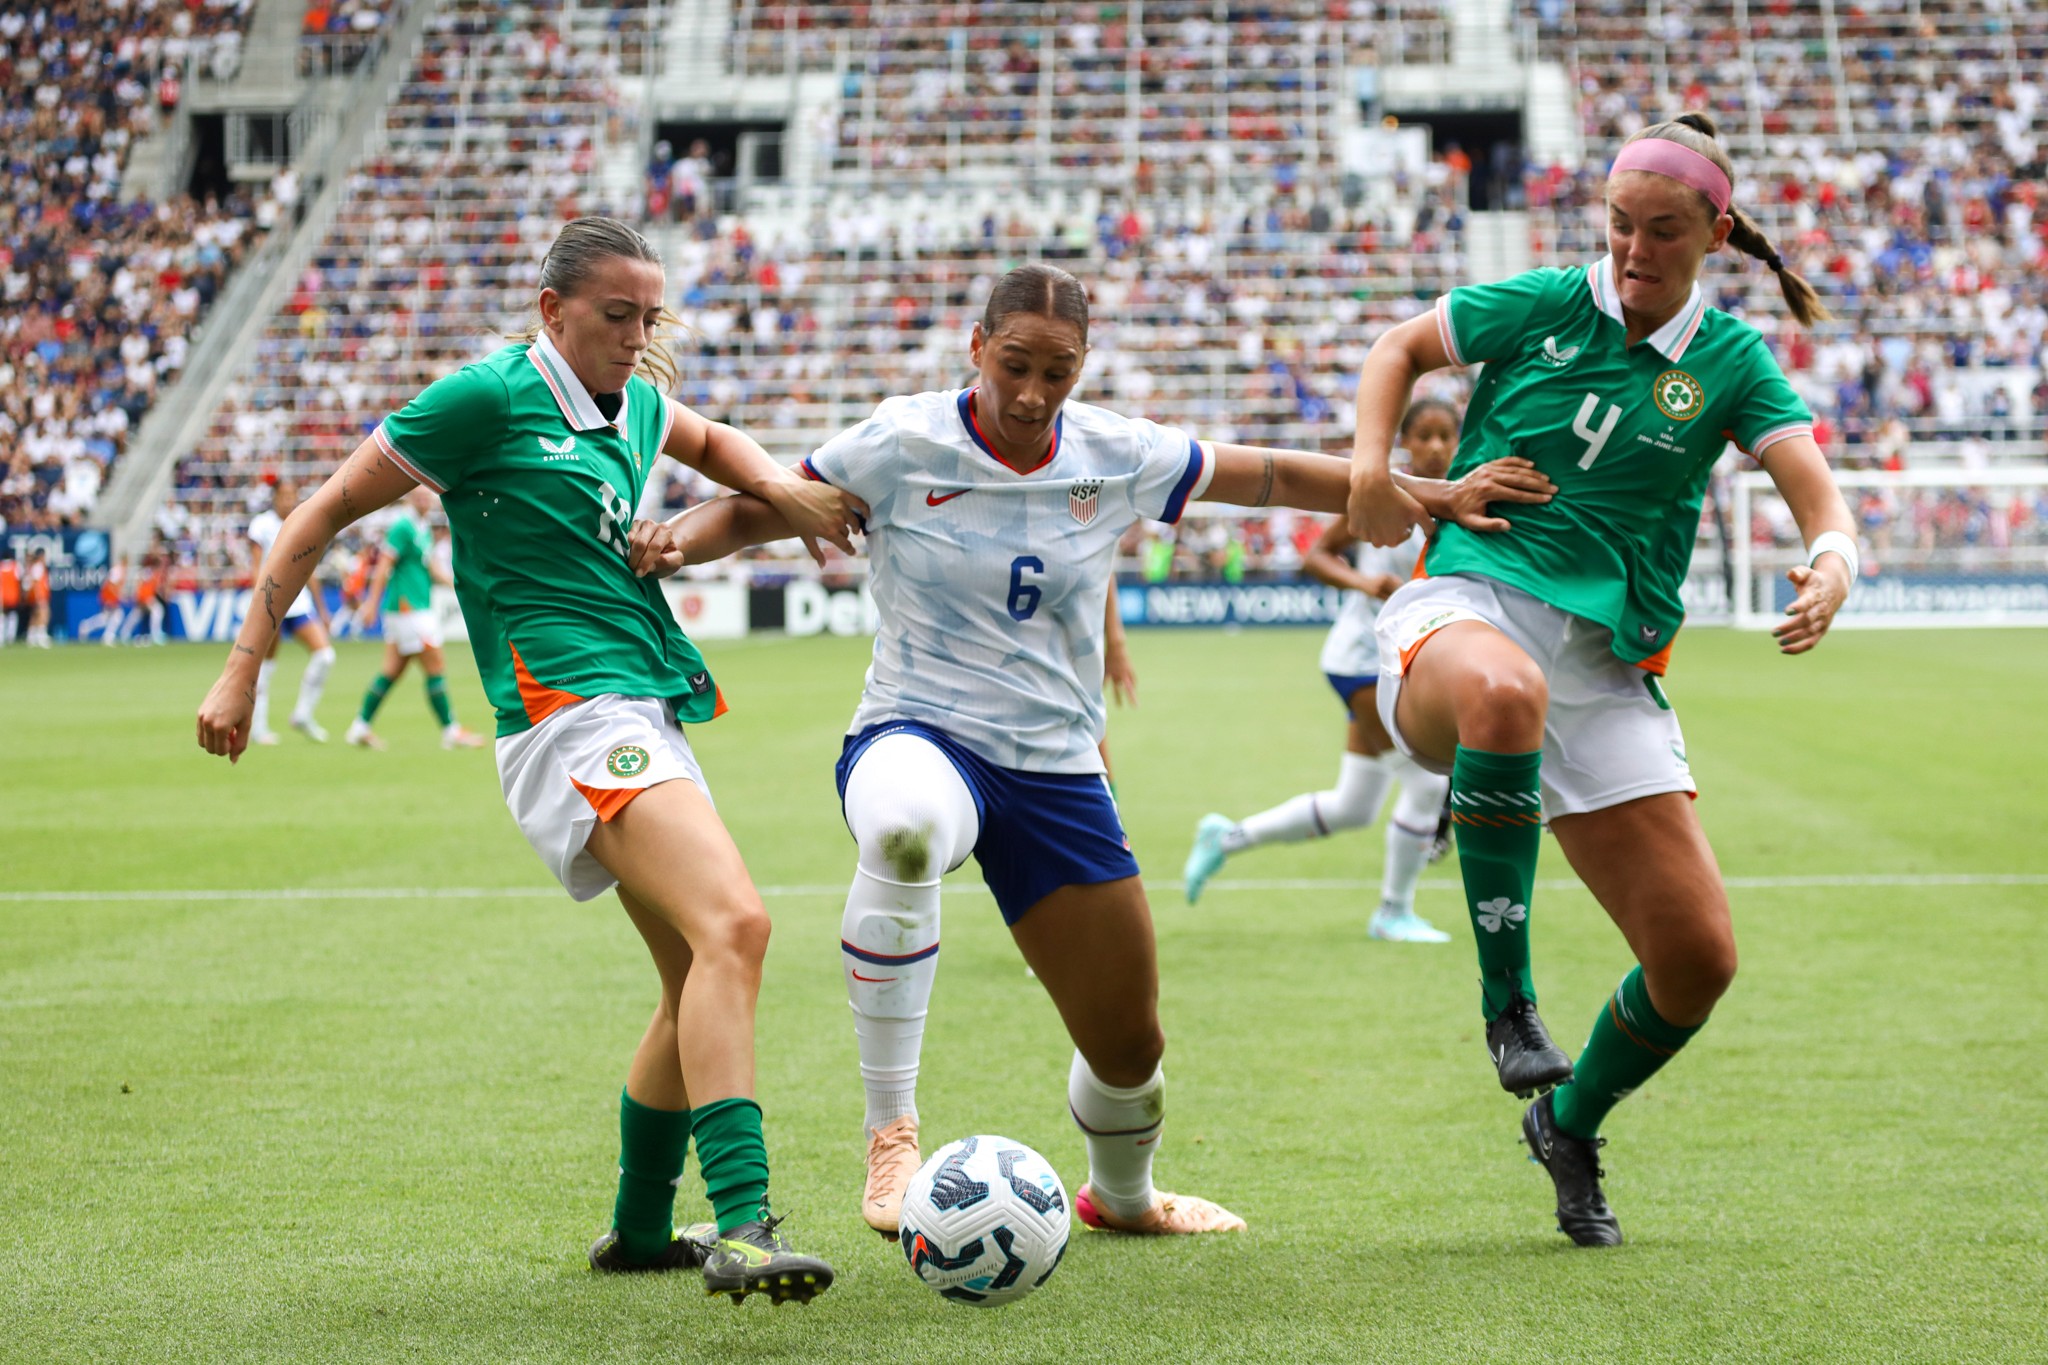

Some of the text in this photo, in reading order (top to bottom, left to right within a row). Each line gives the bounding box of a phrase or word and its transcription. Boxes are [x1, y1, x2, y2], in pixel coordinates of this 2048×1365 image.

[1661, 372, 1701, 397] IRELAND
[1572, 391, 1623, 471] 4
[1660, 432, 1674, 442] USA
[1654, 440, 1672, 450] JUNE
[543, 454, 580, 462] CASTORE
[1071, 483, 1099, 500] USA
[1007, 555, 1044, 622] 6
[1146, 586, 1232, 623] NEW
[1229, 585, 1324, 623] YORK
